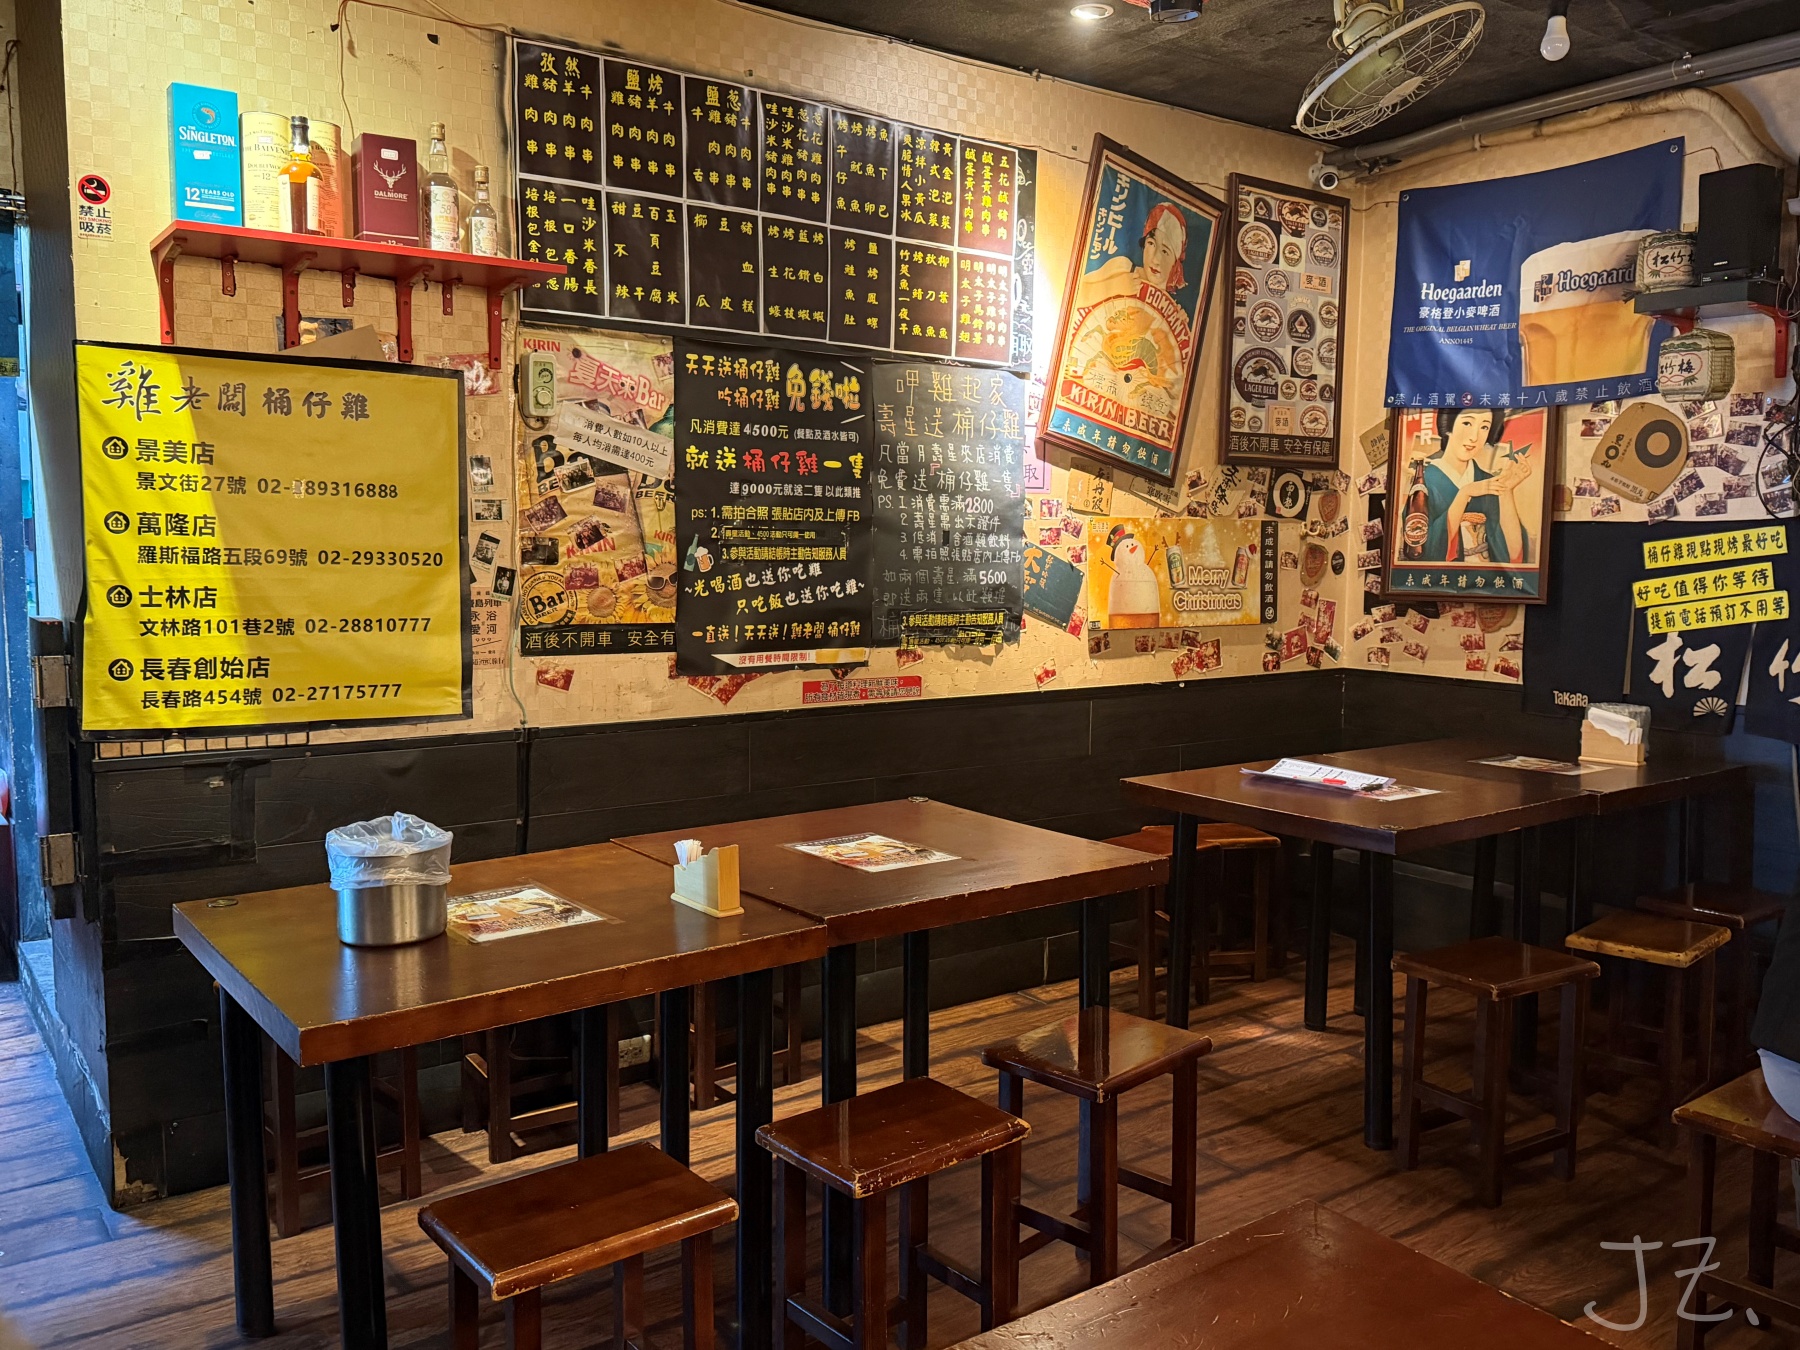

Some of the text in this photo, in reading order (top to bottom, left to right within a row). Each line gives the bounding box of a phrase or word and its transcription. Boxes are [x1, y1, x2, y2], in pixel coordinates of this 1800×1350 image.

[178, 124, 237, 148] SINGLETON
[184, 186, 235, 201] 12 YEARS OLD
[374, 190, 408, 200] DALMORE
[79, 204, 111, 219] 禁止
[440, 204, 452, 215] 58
[1102, 172, 1131, 255] キリンビール
[79, 221, 112, 235] 吸菸
[1420, 279, 1503, 304] Hoegaarden
[1418, 303, 1501, 320] 豪格登小麥啤酒
[1415, 325, 1446, 333] ORIGINAL
[1446, 325, 1474, 333] BELGIAN
[1474, 323, 1497, 331] WHEAT
[1498, 322, 1517, 330] BEER
[523, 337, 561, 353] KIRIN
[685, 353, 780, 383] 天天送桶仔雞
[101, 359, 371, 422] 雞老闆桶仔雞
[717, 386, 780, 412] 吃桶仔雞
[896, 369, 1008, 408] 呷雞起家
[1244, 383, 1276, 395] LAGER BEER
[1394, 377, 1654, 406] 禁止酒駕 未滿十八歲禁止飲酒
[877, 402, 1024, 442] 壽星送桶仔雞
[572, 431, 655, 469] 每人均消需達400元
[583, 418, 669, 458] 消費人數如10人以上
[1062, 418, 1159, 466] 未成年請勿飲酒
[1228, 435, 1331, 455] 酒後不開車 安全有保障
[134, 437, 216, 467] 景美店
[685, 444, 864, 479] 就送桶仔雞一隻
[878, 441, 1016, 465] 凡當月壽星來店消費
[135, 471, 248, 497] 景文街27號
[825, 486, 862, 499] 以此類推
[136, 511, 217, 539] 萬隆店
[137, 545, 444, 568] 羅斯福路五段69號 02-29330520
[1647, 530, 1784, 564] 桶仔雞現點現烤最好吃
[1188, 565, 1230, 590] Merry
[1265, 526, 1274, 604] 未成年請勿飲酒
[1405, 573, 1524, 590] 未成年請勿飲酒
[1636, 567, 1770, 602] 好吃值得你等待
[138, 584, 218, 610] 士林店
[529, 591, 564, 614] Bar
[1173, 590, 1242, 611] Christmas
[1650, 596, 1786, 631] 提前電話預訂不用等
[139, 616, 432, 638] 文林路101巷2號 02-28810777
[525, 631, 675, 649] 酒後不開車 安全有
[139, 654, 271, 682] 長春創始店
[1646, 631, 1722, 699] 松
[141, 683, 403, 710] 長春路454號 02-27175777
